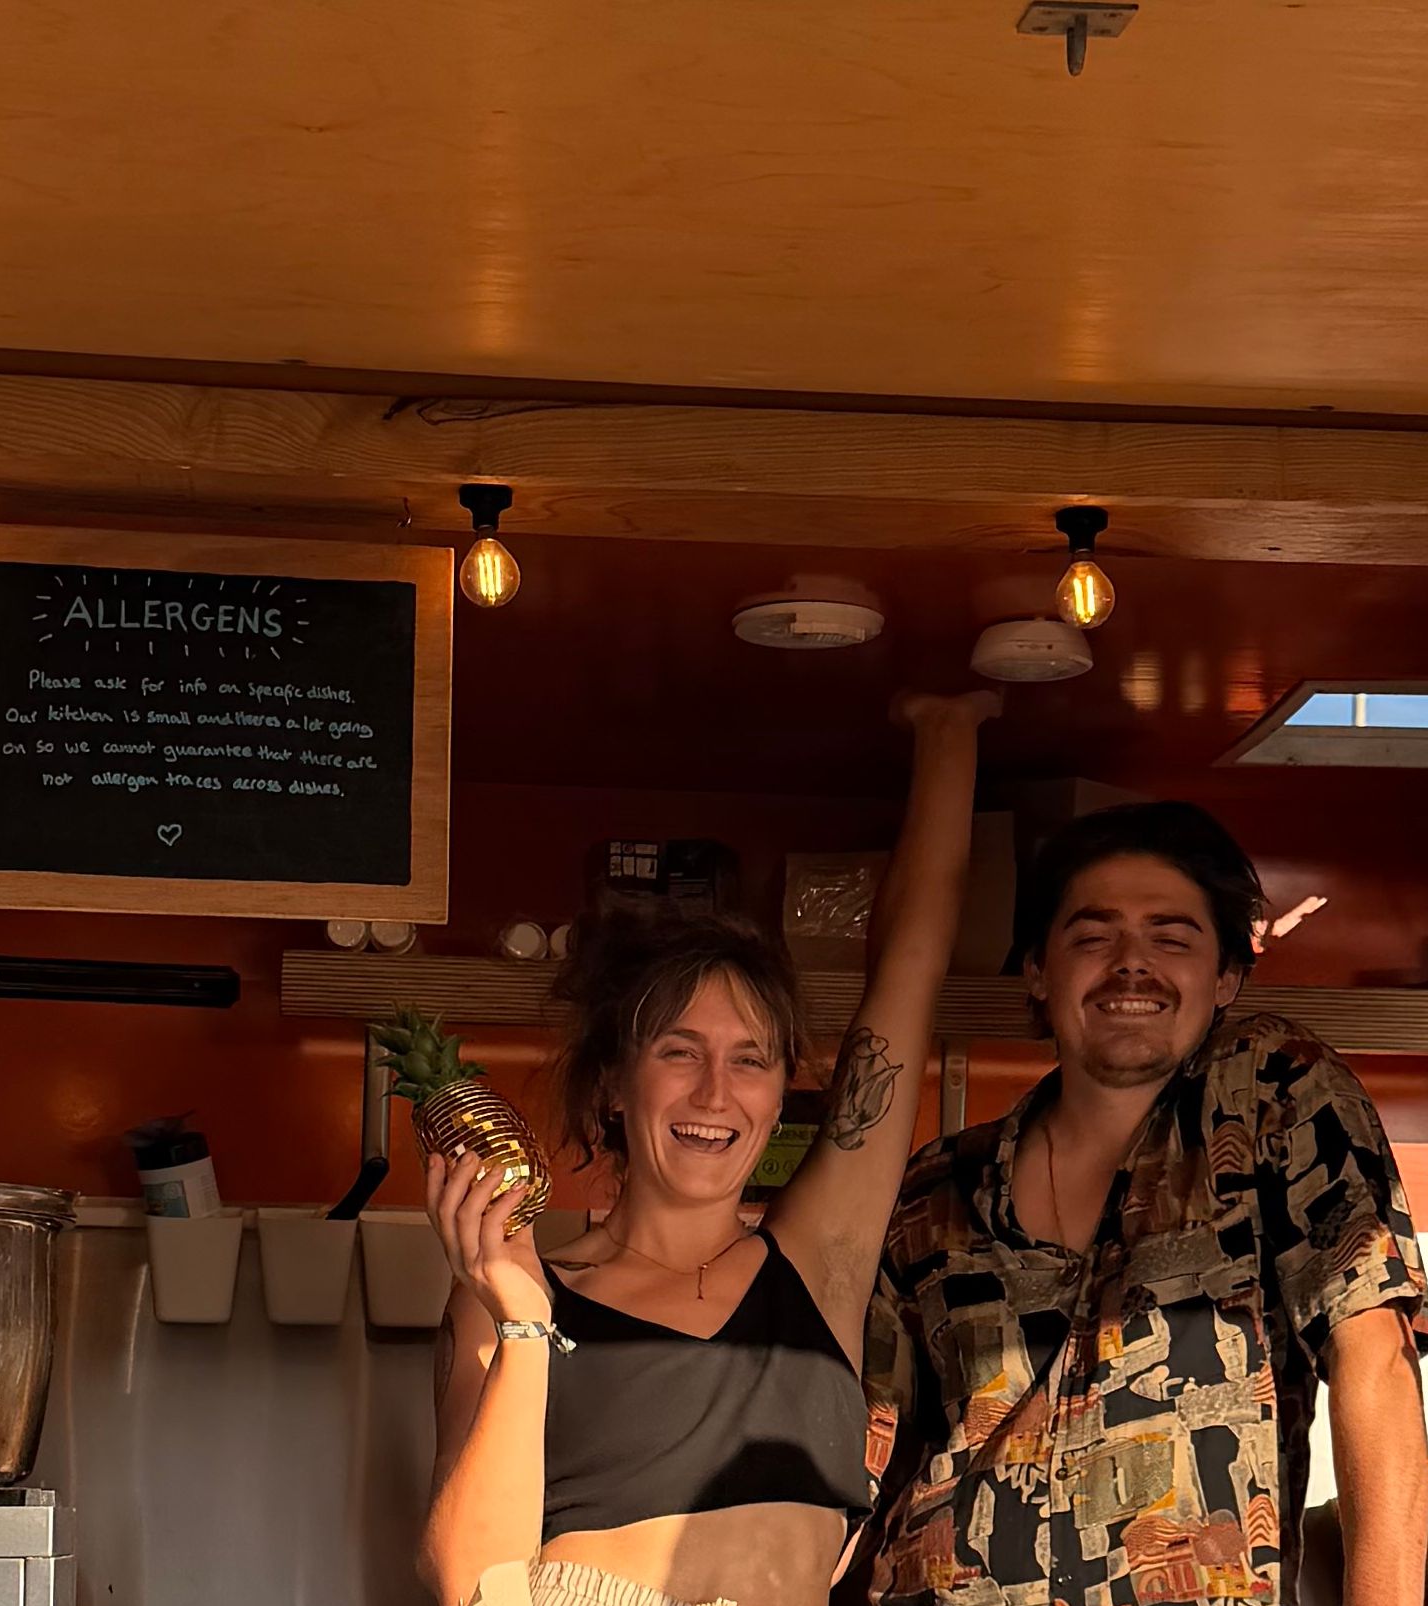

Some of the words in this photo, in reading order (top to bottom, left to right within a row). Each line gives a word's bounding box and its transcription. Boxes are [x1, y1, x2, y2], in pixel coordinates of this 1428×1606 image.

[63, 596, 283, 638] ALLERGENS
[29, 669, 82, 690] Please
[94, 676, 127, 690] ask
[141, 677, 165, 697] for
[179, 677, 208, 696] info
[218, 684, 241, 695] on
[5, 707, 38, 724] Our
[48, 704, 114, 723] kitchen
[147, 710, 191, 726] small
[197, 712, 233, 725] and
[285, 718, 301, 729] a
[328, 721, 374, 739] going
[2, 743, 27, 755] on
[35, 740, 55, 753] so
[64, 741, 91, 754] we
[102, 740, 156, 755] cannot
[164, 744, 254, 762] guarantee
[257, 744, 292, 762] that
[299, 750, 343, 768] there
[346, 755, 378, 769] are
[42, 772, 73, 786] not
[91, 771, 159, 793] allergen
[165, 771, 222, 791] traces
[232, 777, 283, 793] across
